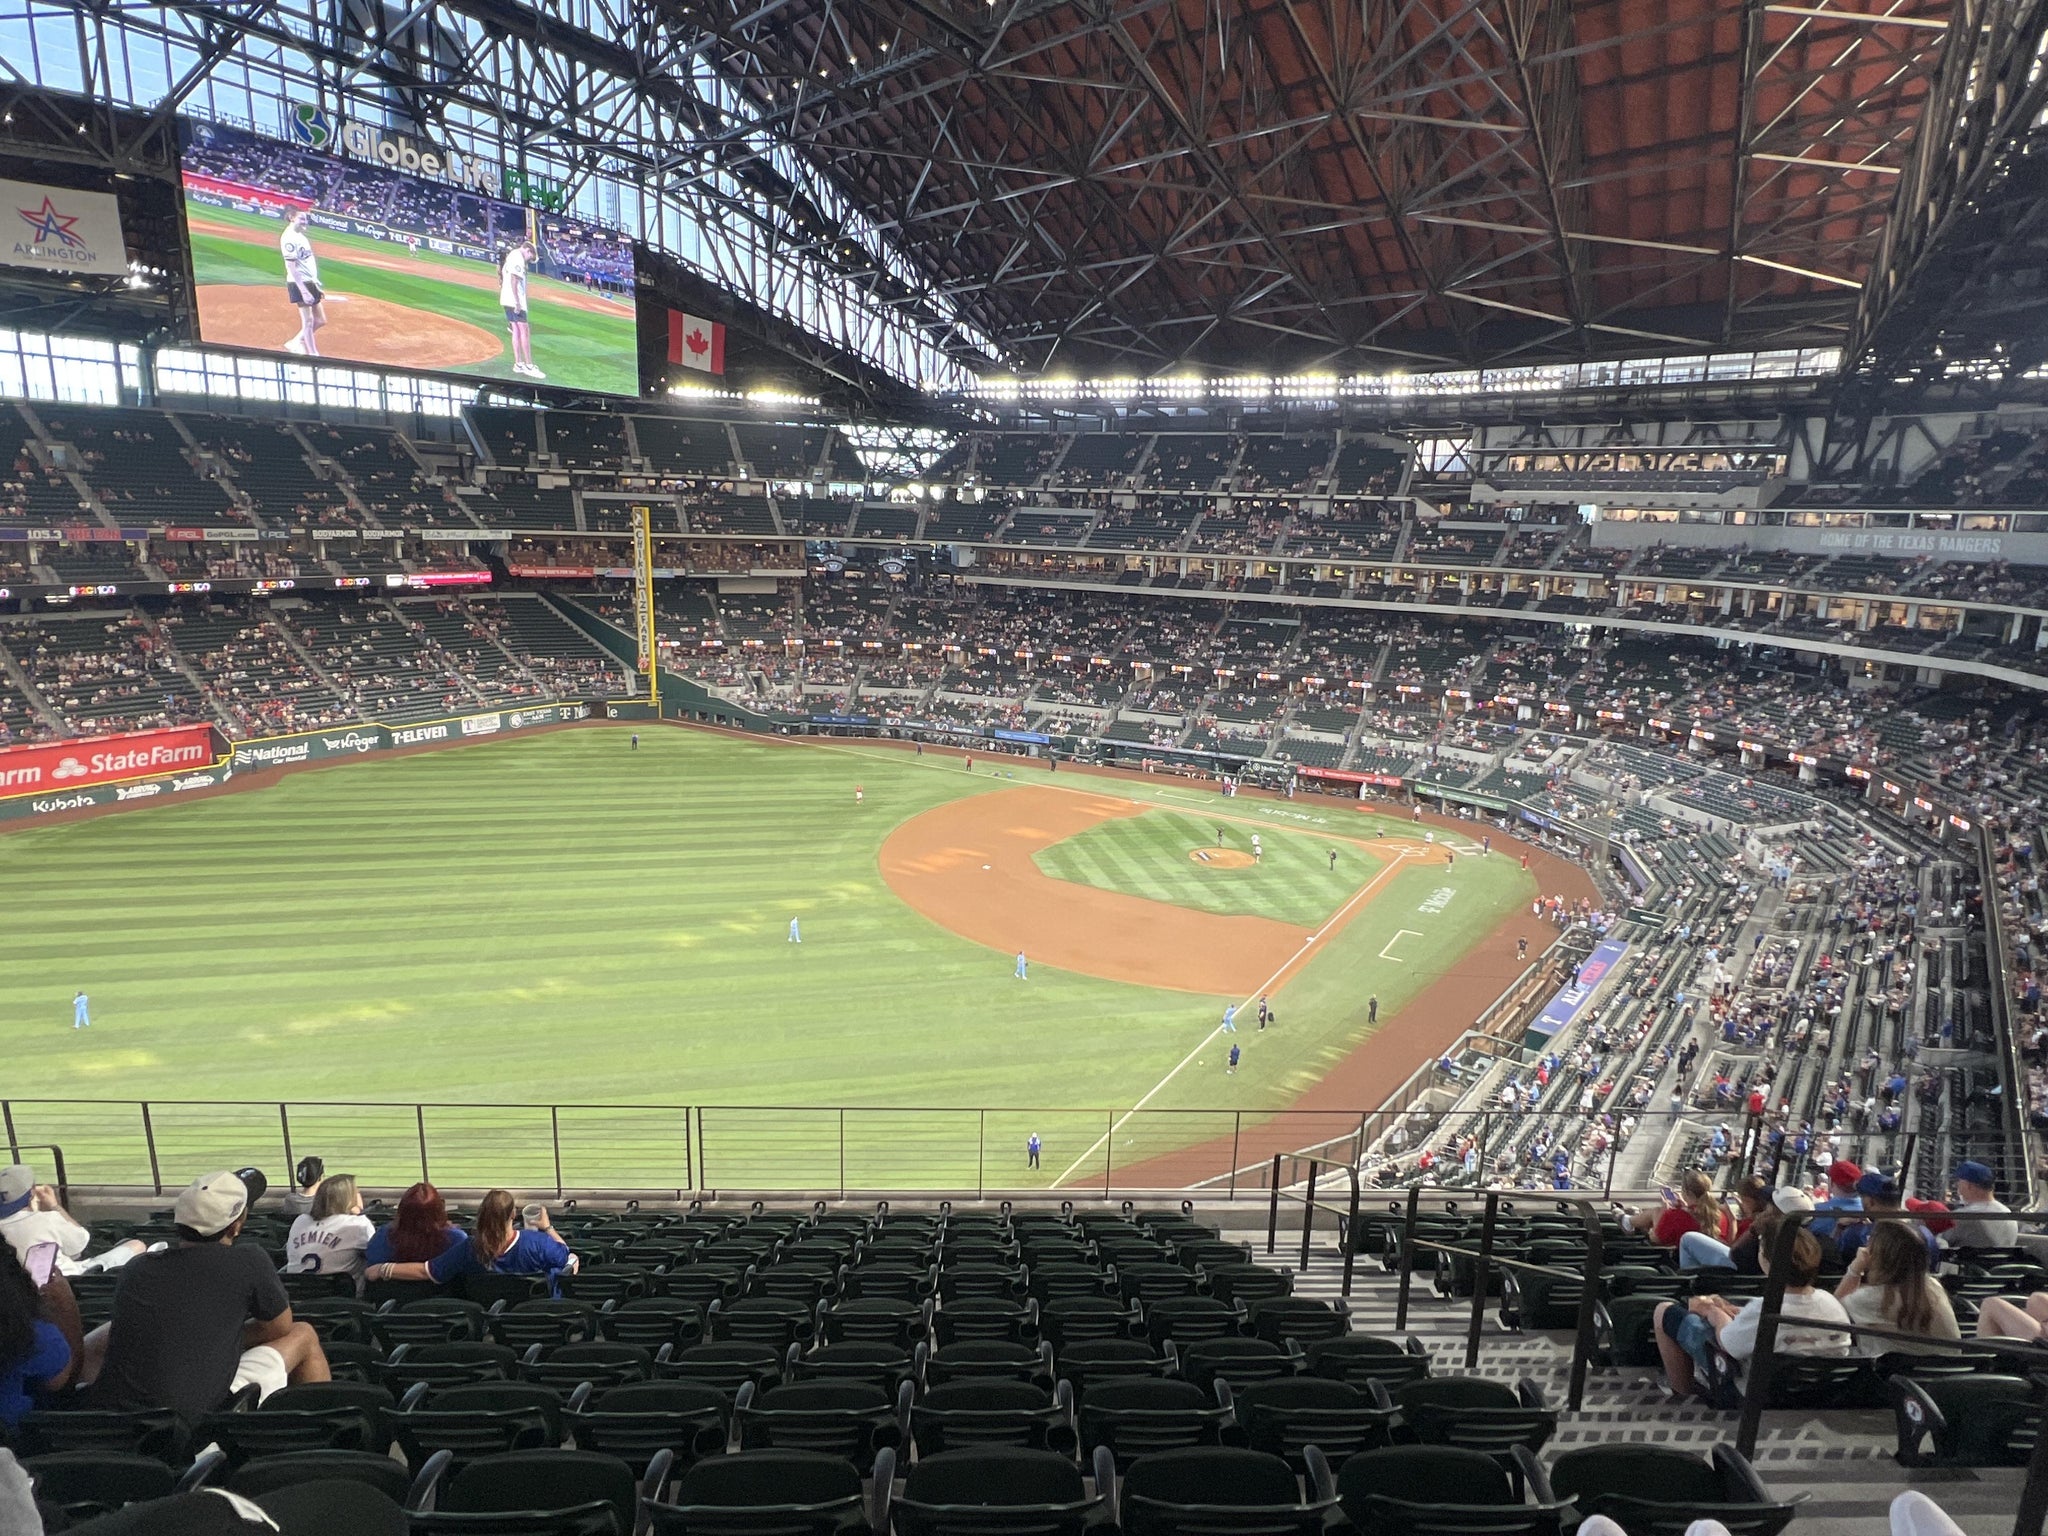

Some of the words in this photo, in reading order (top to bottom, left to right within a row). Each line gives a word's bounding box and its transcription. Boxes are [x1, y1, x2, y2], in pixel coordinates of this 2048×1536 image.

[343, 121, 441, 176] Globe
[446, 150, 501, 192] Life
[505, 169, 566, 212] Field
[13, 242, 97, 262] ARLINGTON
[27, 529, 63, 539] 105.3
[268, 531, 289, 539] PGL
[1820, 533, 1851, 547] HOME
[1855, 534, 1871, 548] OF
[1873, 535, 1894, 548] THE
[1899, 536, 1934, 550] TEXAS
[1939, 537, 2001, 553] RANGERS
[341, 732, 380, 752] Kroger
[391, 725, 448, 745] 7-ELEVEN
[252, 742, 310, 761] National
[32, 794, 95, 813] Kubota
[292, 1231, 342, 1249] SEMIEN
